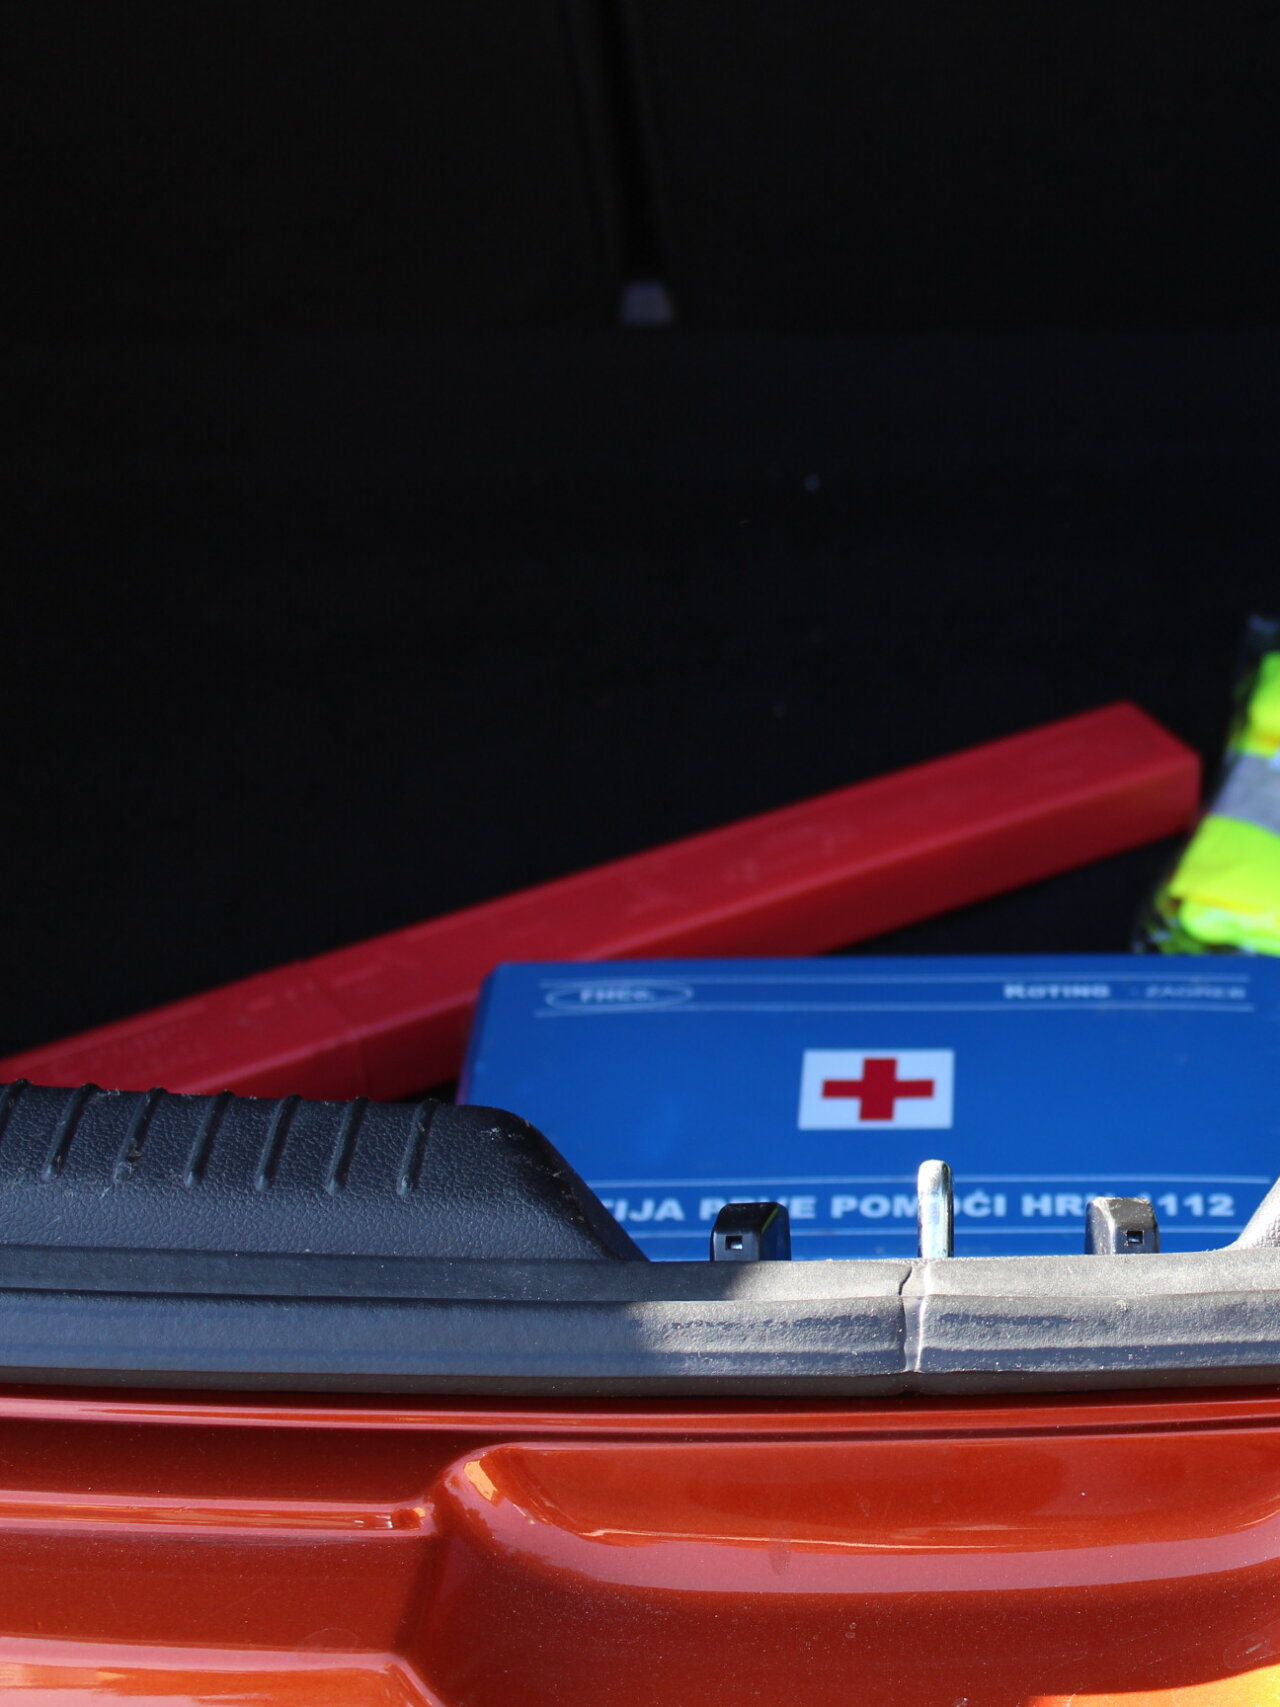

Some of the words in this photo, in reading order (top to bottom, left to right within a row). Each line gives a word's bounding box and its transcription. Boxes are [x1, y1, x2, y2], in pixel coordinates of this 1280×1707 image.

[699, 1195, 817, 1221] PE
[830, 1188, 1007, 1220] POMĆI
[1021, 1192, 1115, 1218] HR
[1136, 1192, 1236, 1218] 112
